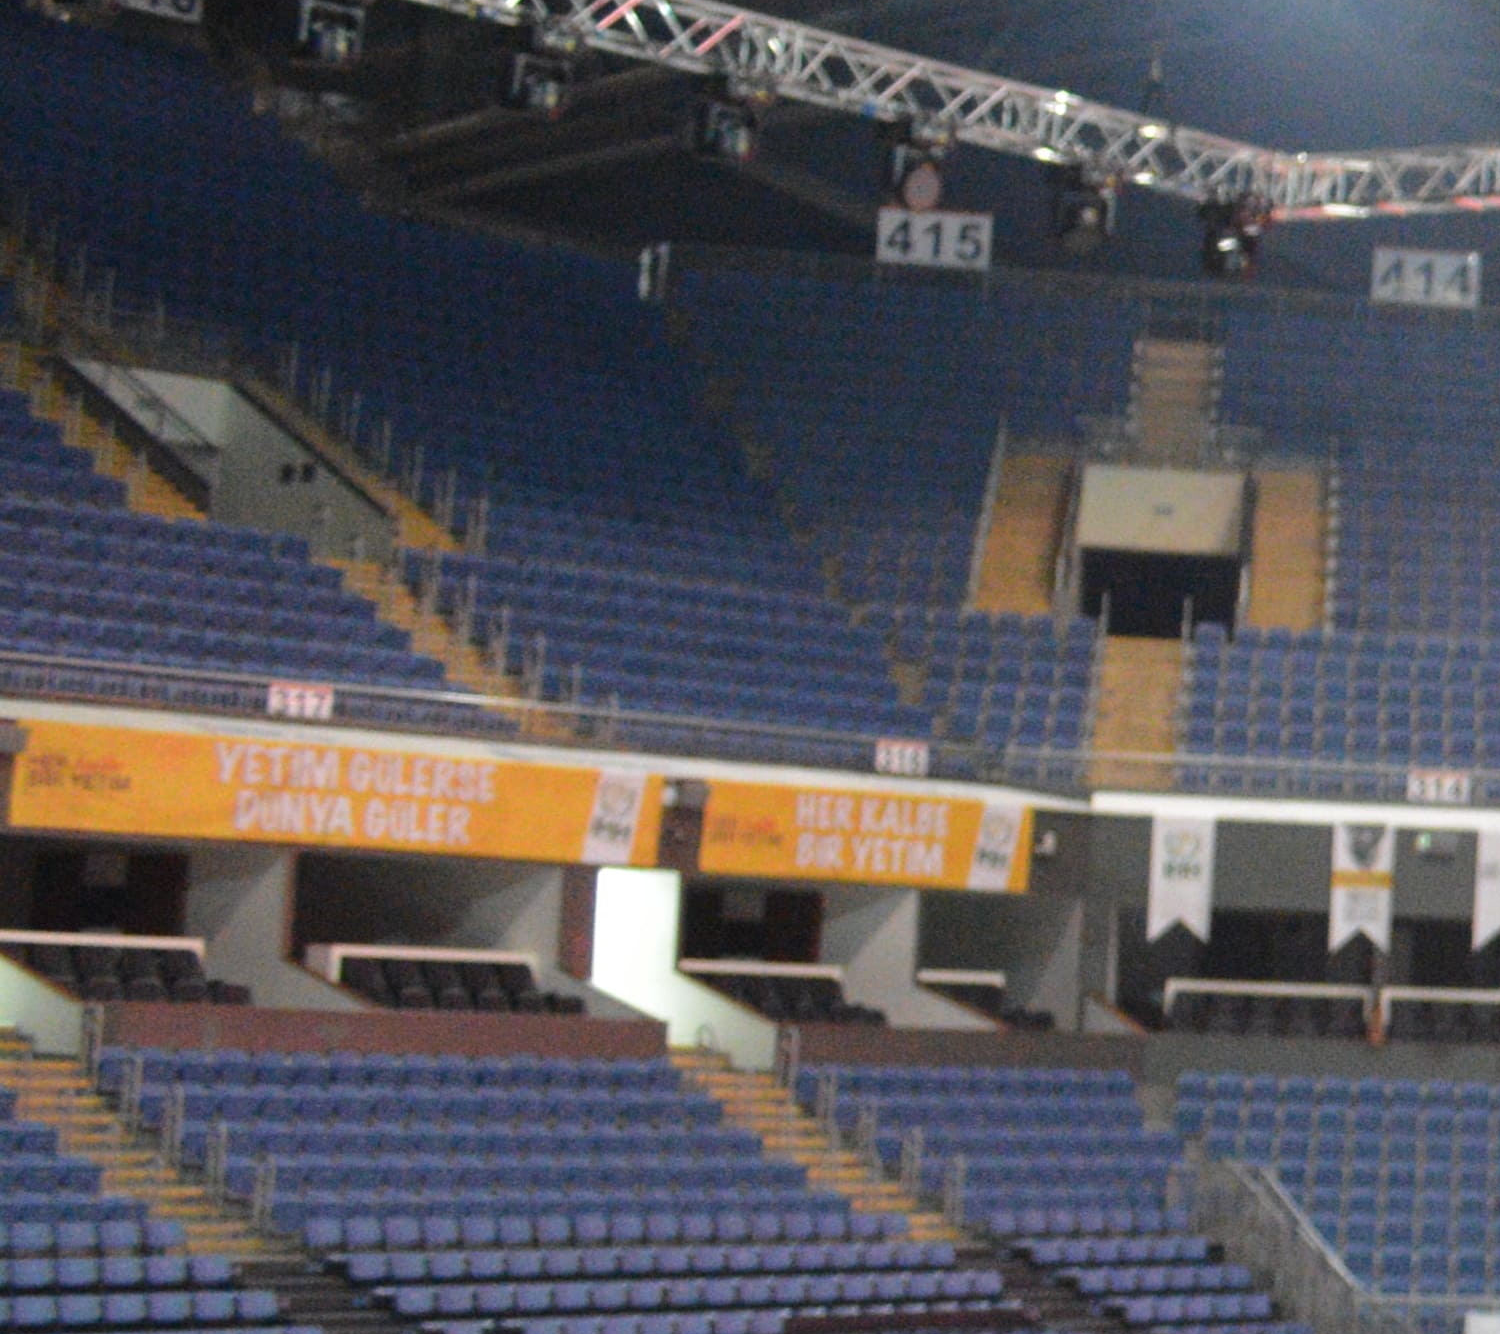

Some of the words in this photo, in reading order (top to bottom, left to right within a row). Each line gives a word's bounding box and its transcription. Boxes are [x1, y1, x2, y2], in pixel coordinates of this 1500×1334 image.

[886, 218, 982, 260] 415
[1380, 257, 1469, 298] 414
[796, 794, 855, 830] HER
[860, 797, 951, 838] KALBE
